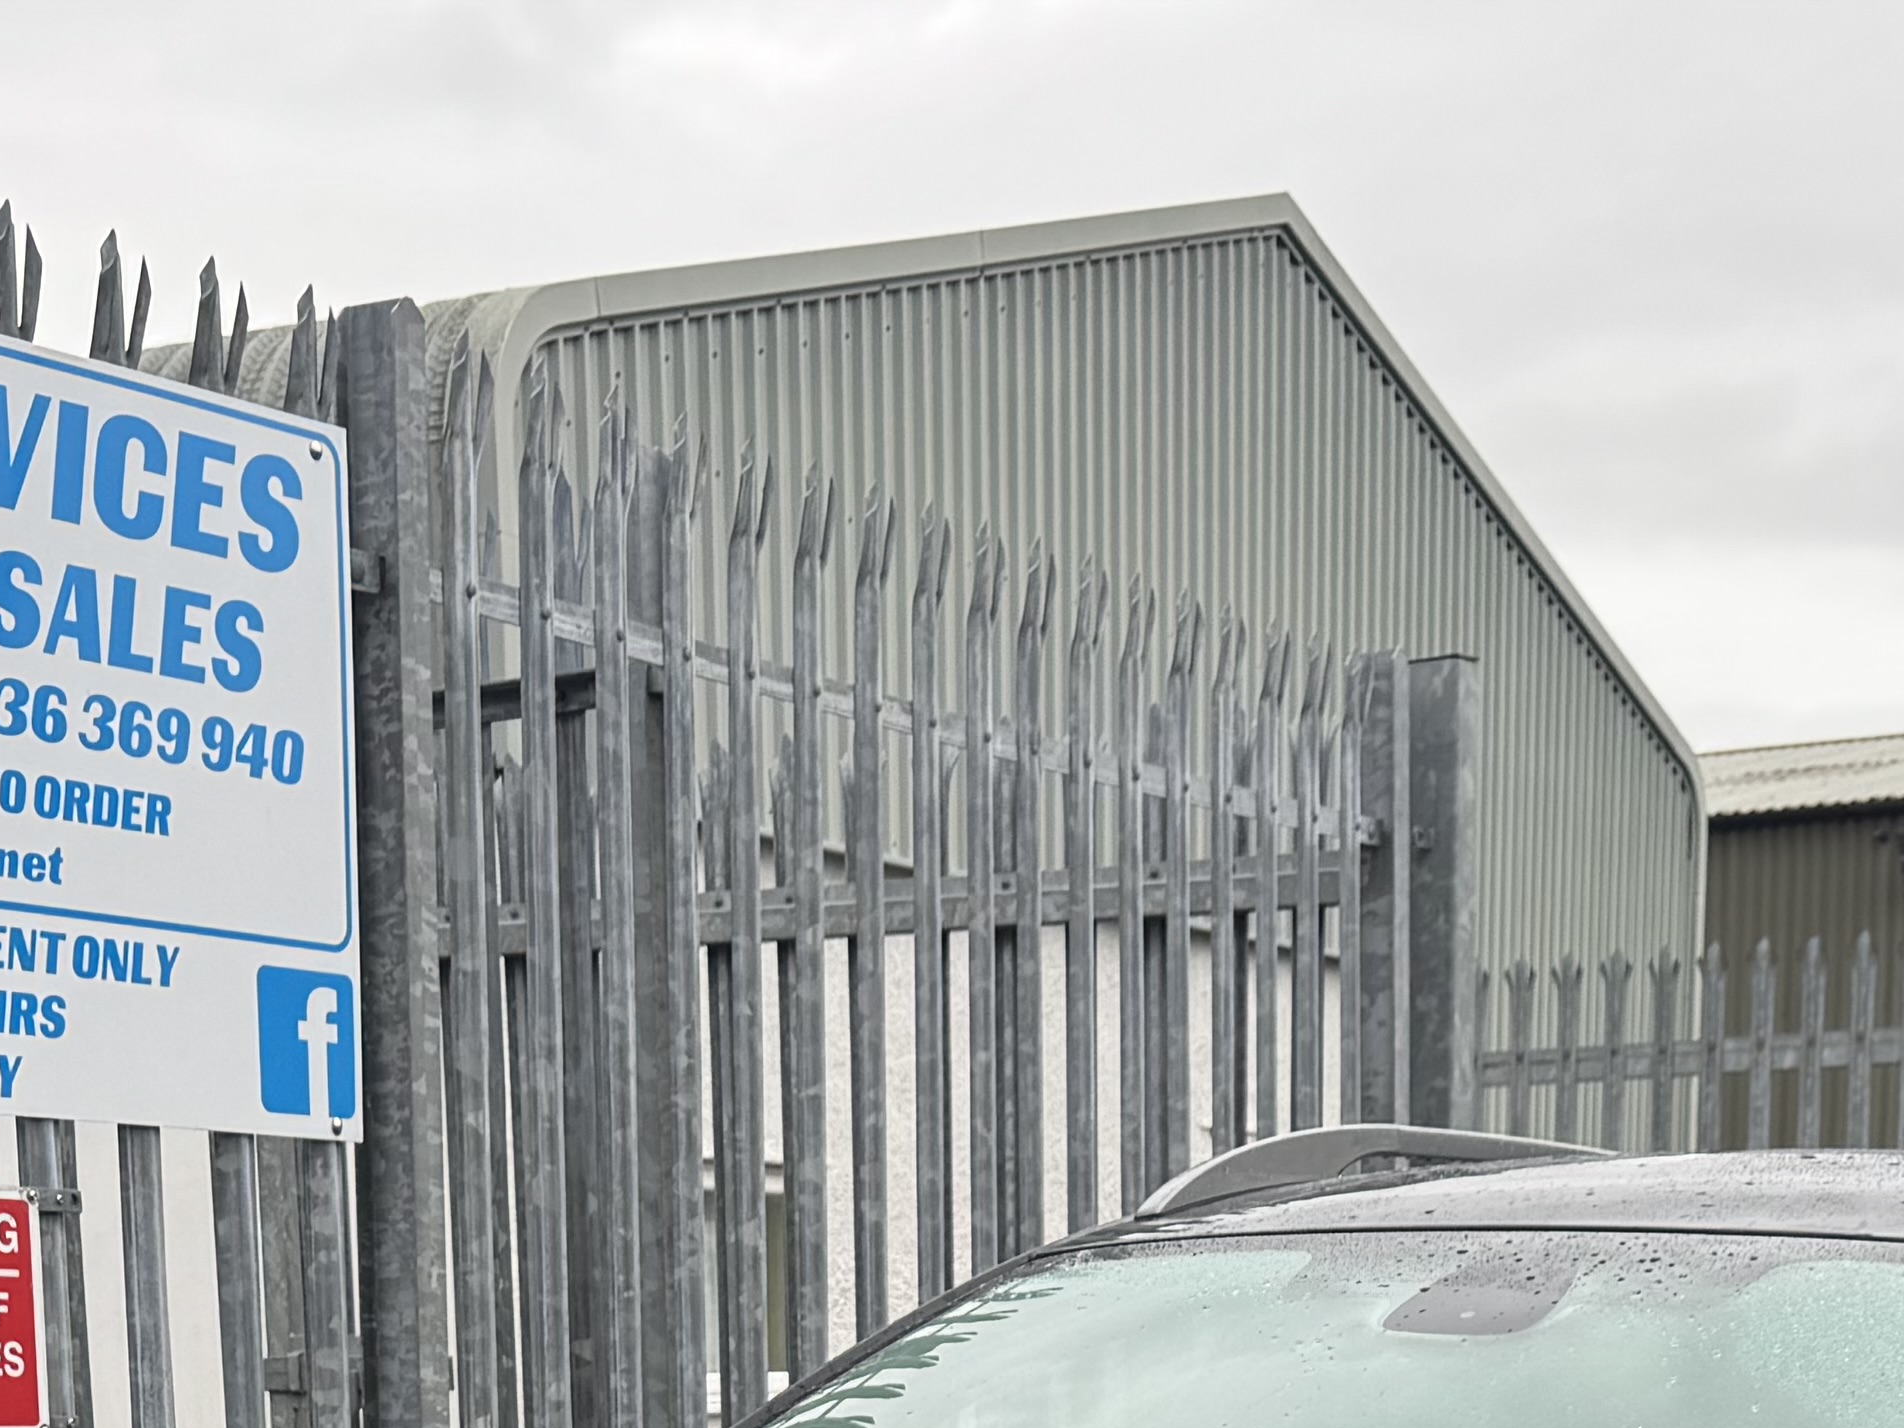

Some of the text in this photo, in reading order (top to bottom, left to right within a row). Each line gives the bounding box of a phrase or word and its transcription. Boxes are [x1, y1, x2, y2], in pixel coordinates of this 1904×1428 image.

[79, 694, 190, 765] 369
[201, 716, 304, 785] 940
[34, 775, 172, 836] ORDER
[72, 935, 180, 987] ONLY
